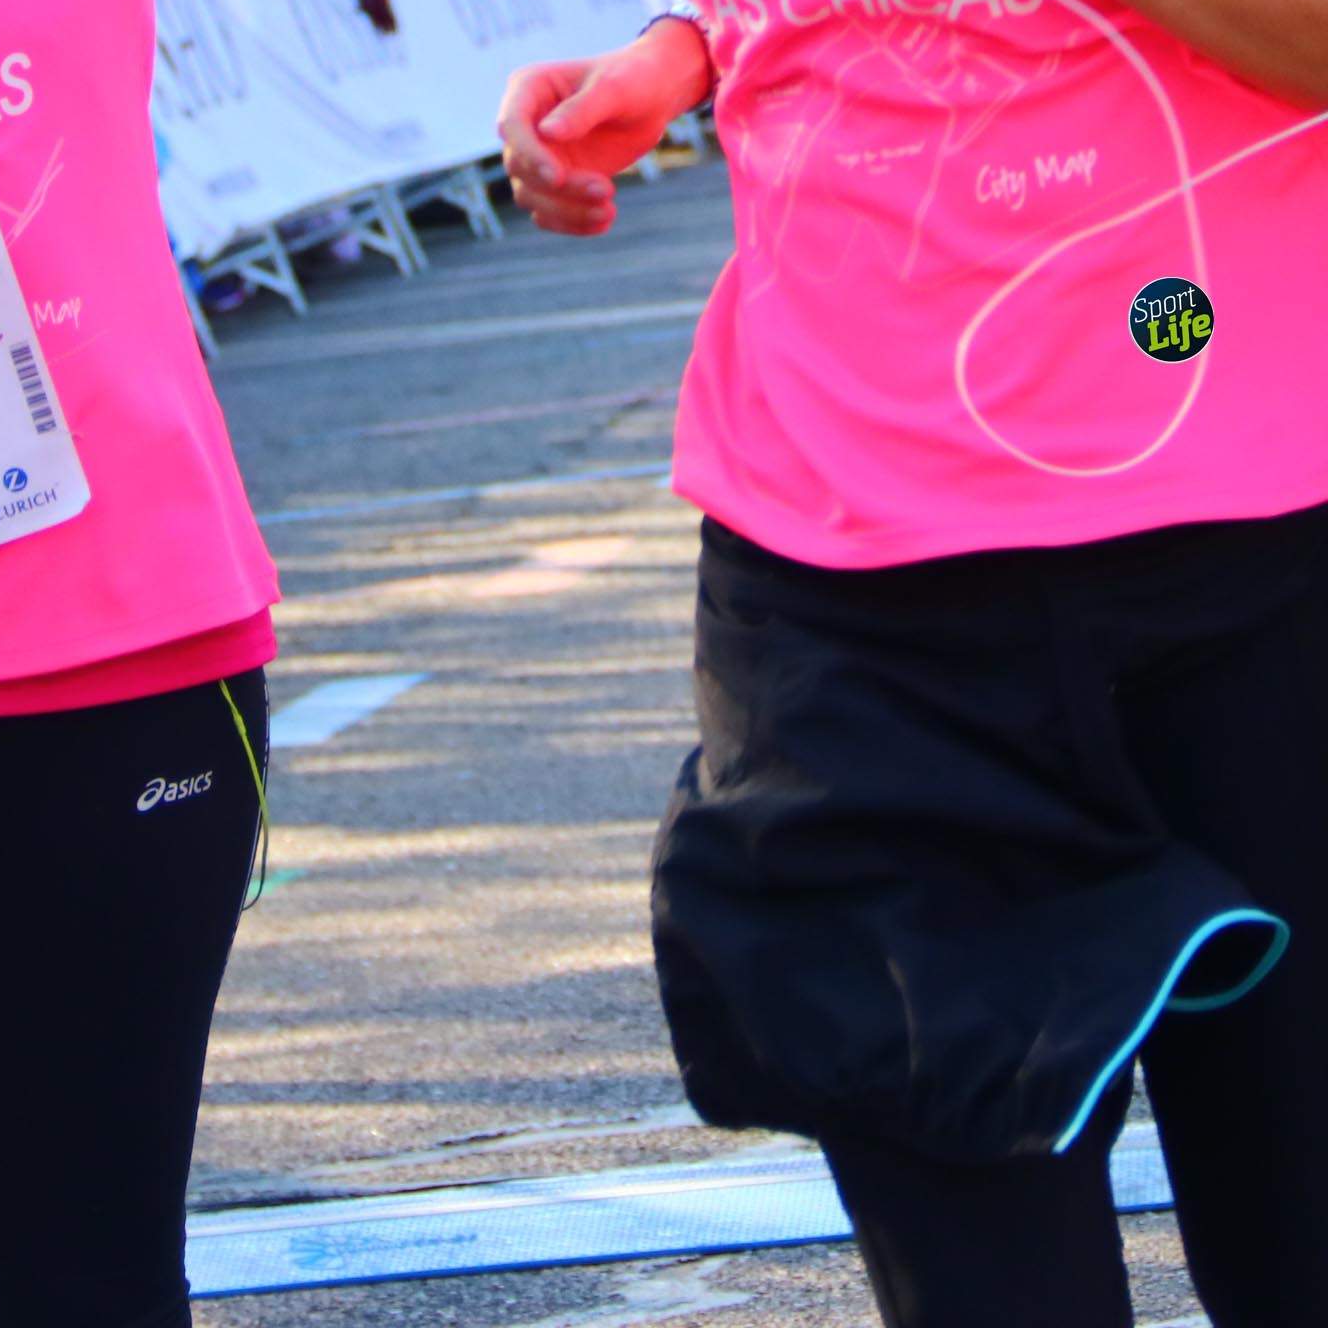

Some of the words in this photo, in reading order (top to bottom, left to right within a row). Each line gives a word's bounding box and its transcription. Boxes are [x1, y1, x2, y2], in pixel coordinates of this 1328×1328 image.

[975, 164, 1029, 212] City
[1034, 148, 1097, 189] Map
[33, 296, 82, 330] Map
